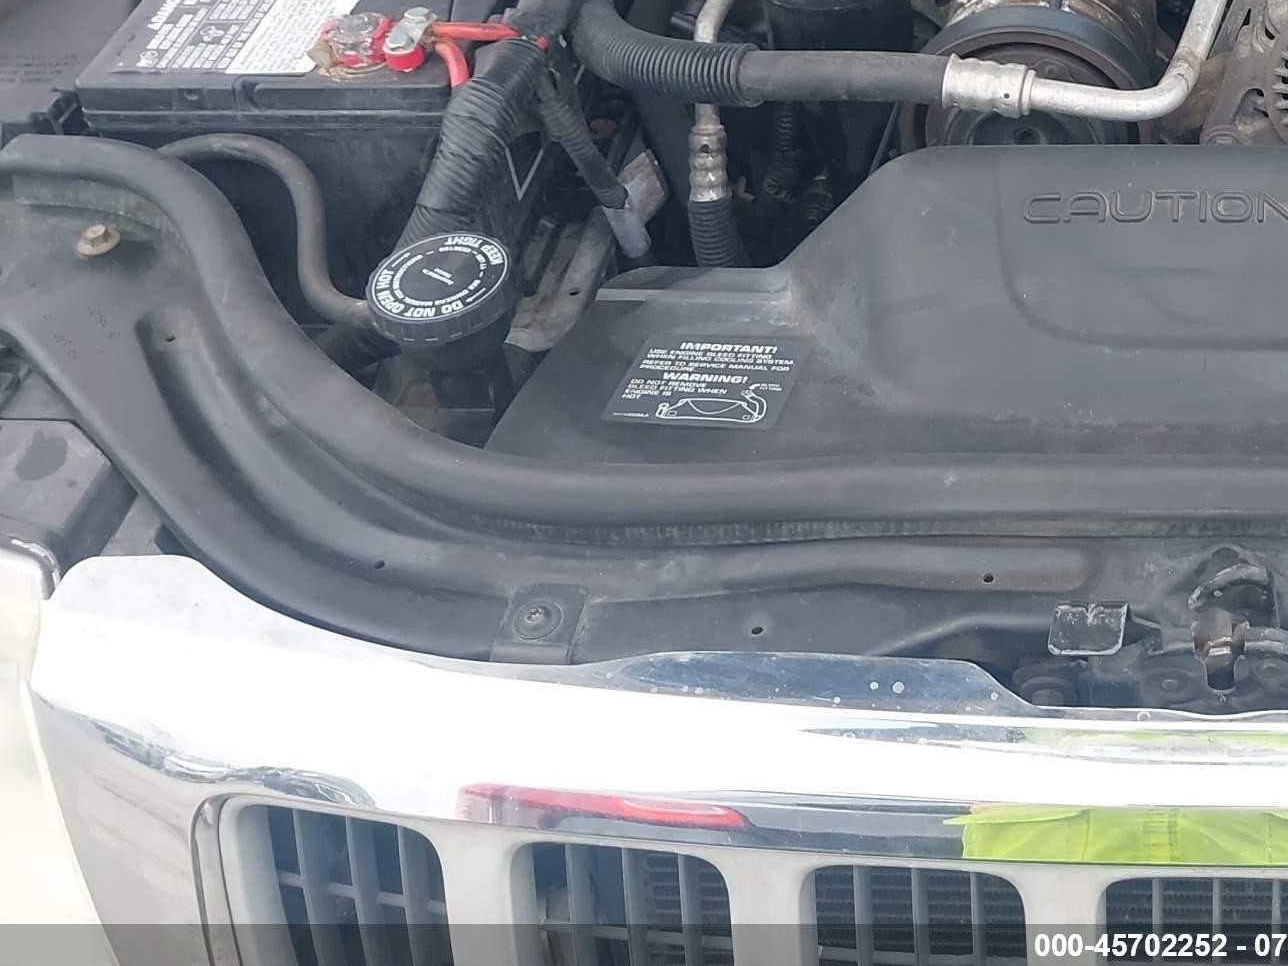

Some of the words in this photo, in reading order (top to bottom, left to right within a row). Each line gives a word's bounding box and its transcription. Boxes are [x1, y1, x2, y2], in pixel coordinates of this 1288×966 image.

[444, 236, 484, 248] TIGHT
[480, 244, 504, 266] KEEP
[376, 269, 395, 289] HOT
[376, 290, 405, 314] OPEN
[441, 300, 464, 314] DO
[403, 307, 436, 318] NOT
[680, 342, 778, 354] IMPORTANT!
[688, 361, 727, 369] SERVICE
[663, 372, 748, 384] WARNING!
